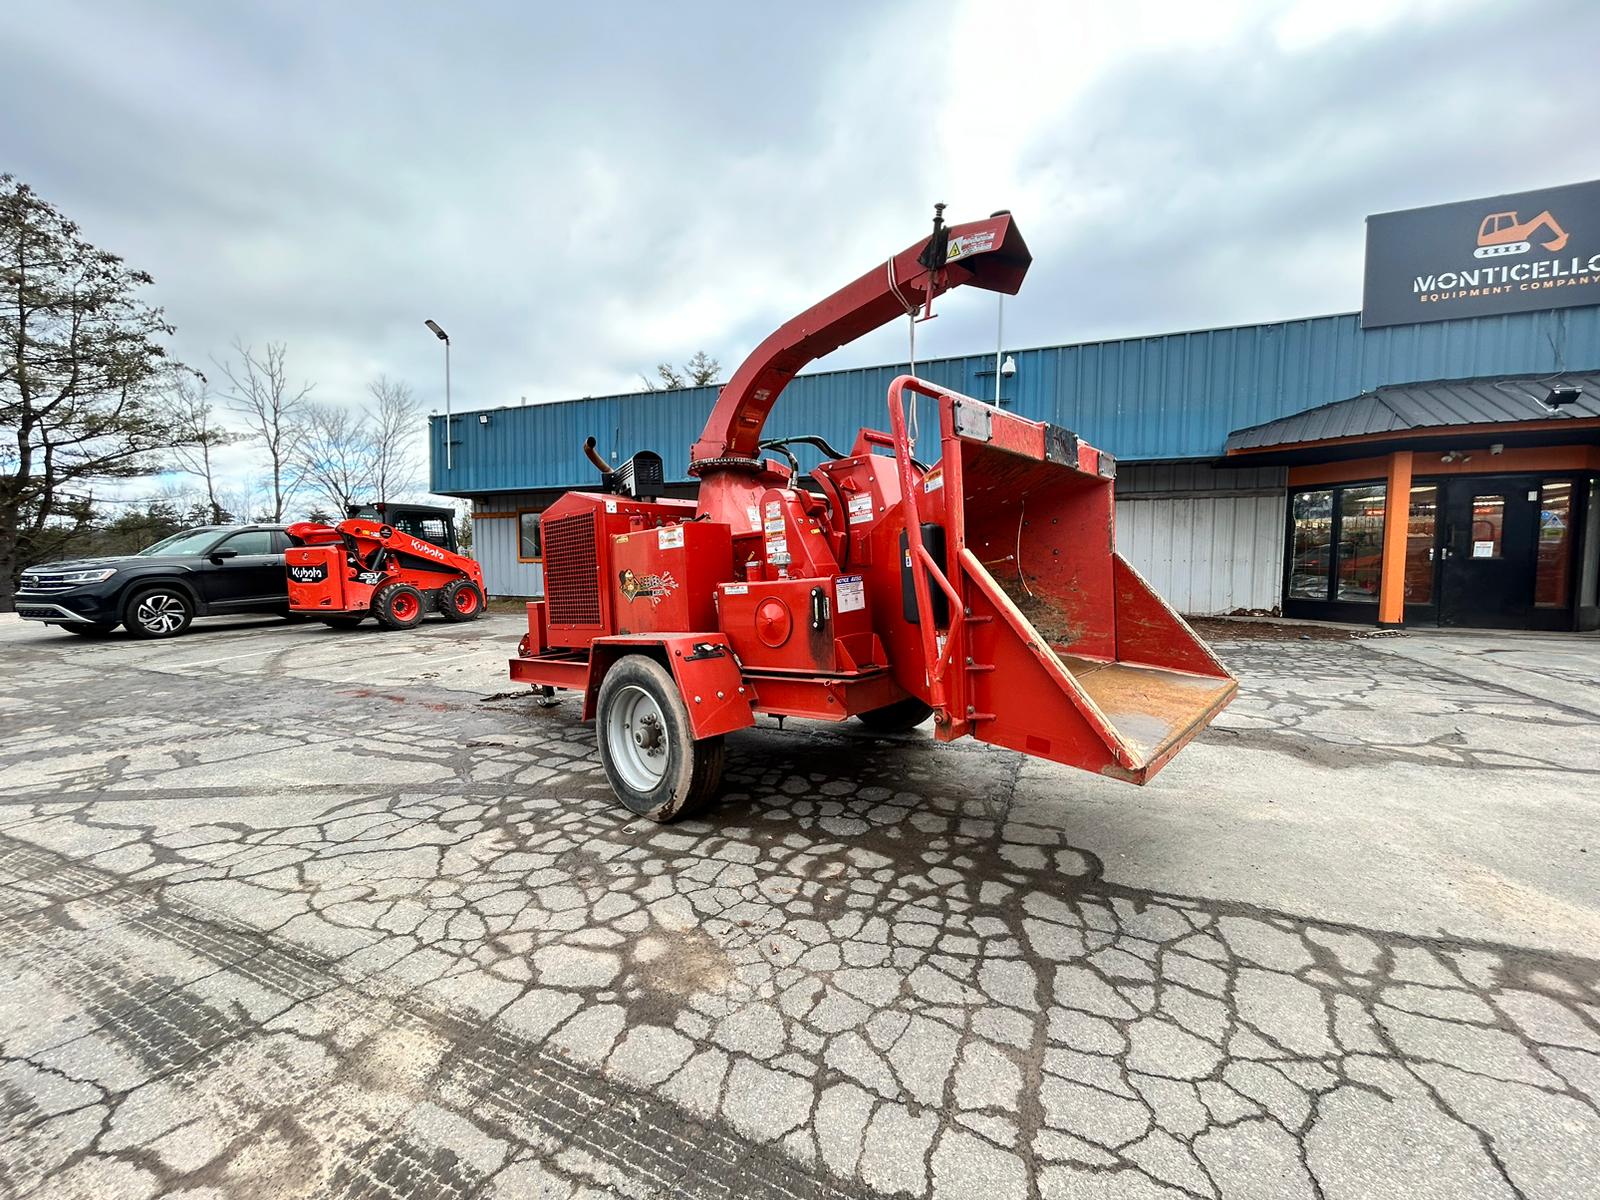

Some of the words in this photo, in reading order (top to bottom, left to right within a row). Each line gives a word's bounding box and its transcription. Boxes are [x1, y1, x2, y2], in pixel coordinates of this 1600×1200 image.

[1413, 254, 1600, 292] MONTICELLO
[1420, 285, 1512, 302] EQUIPMENT
[1519, 274, 1600, 291] COMPANY
[411, 539, 444, 560] Kubota
[292, 566, 322, 578] Kubota
[358, 572, 382, 580] SSV
